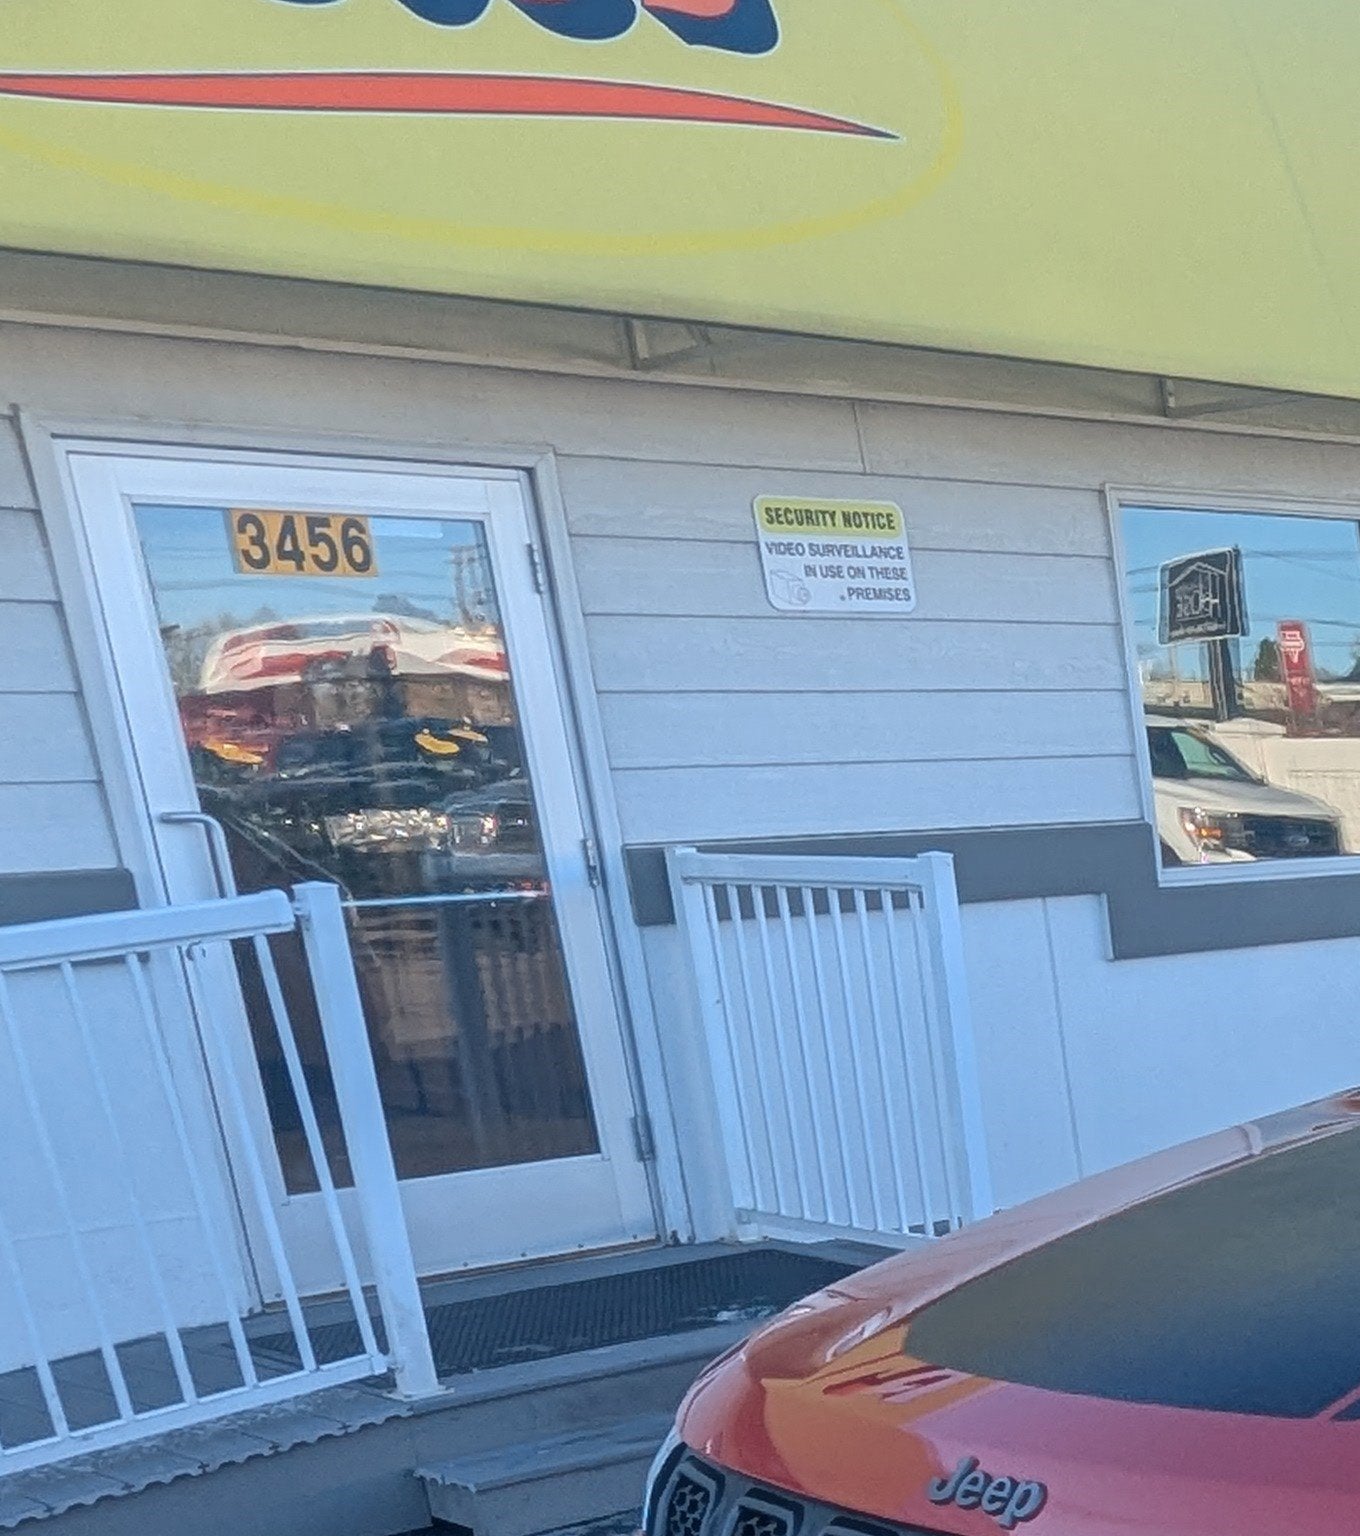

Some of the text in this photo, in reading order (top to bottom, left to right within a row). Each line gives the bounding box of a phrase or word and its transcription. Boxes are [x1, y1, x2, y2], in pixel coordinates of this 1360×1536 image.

[765, 507, 896, 530] SECURITY NOTICE
[237, 513, 372, 573] 3456
[765, 542, 905, 560] VIDEO SURVEILLANCE
[804, 564, 908, 581] IN USE ON THESE
[928, 1456, 1048, 1530] Jeep
